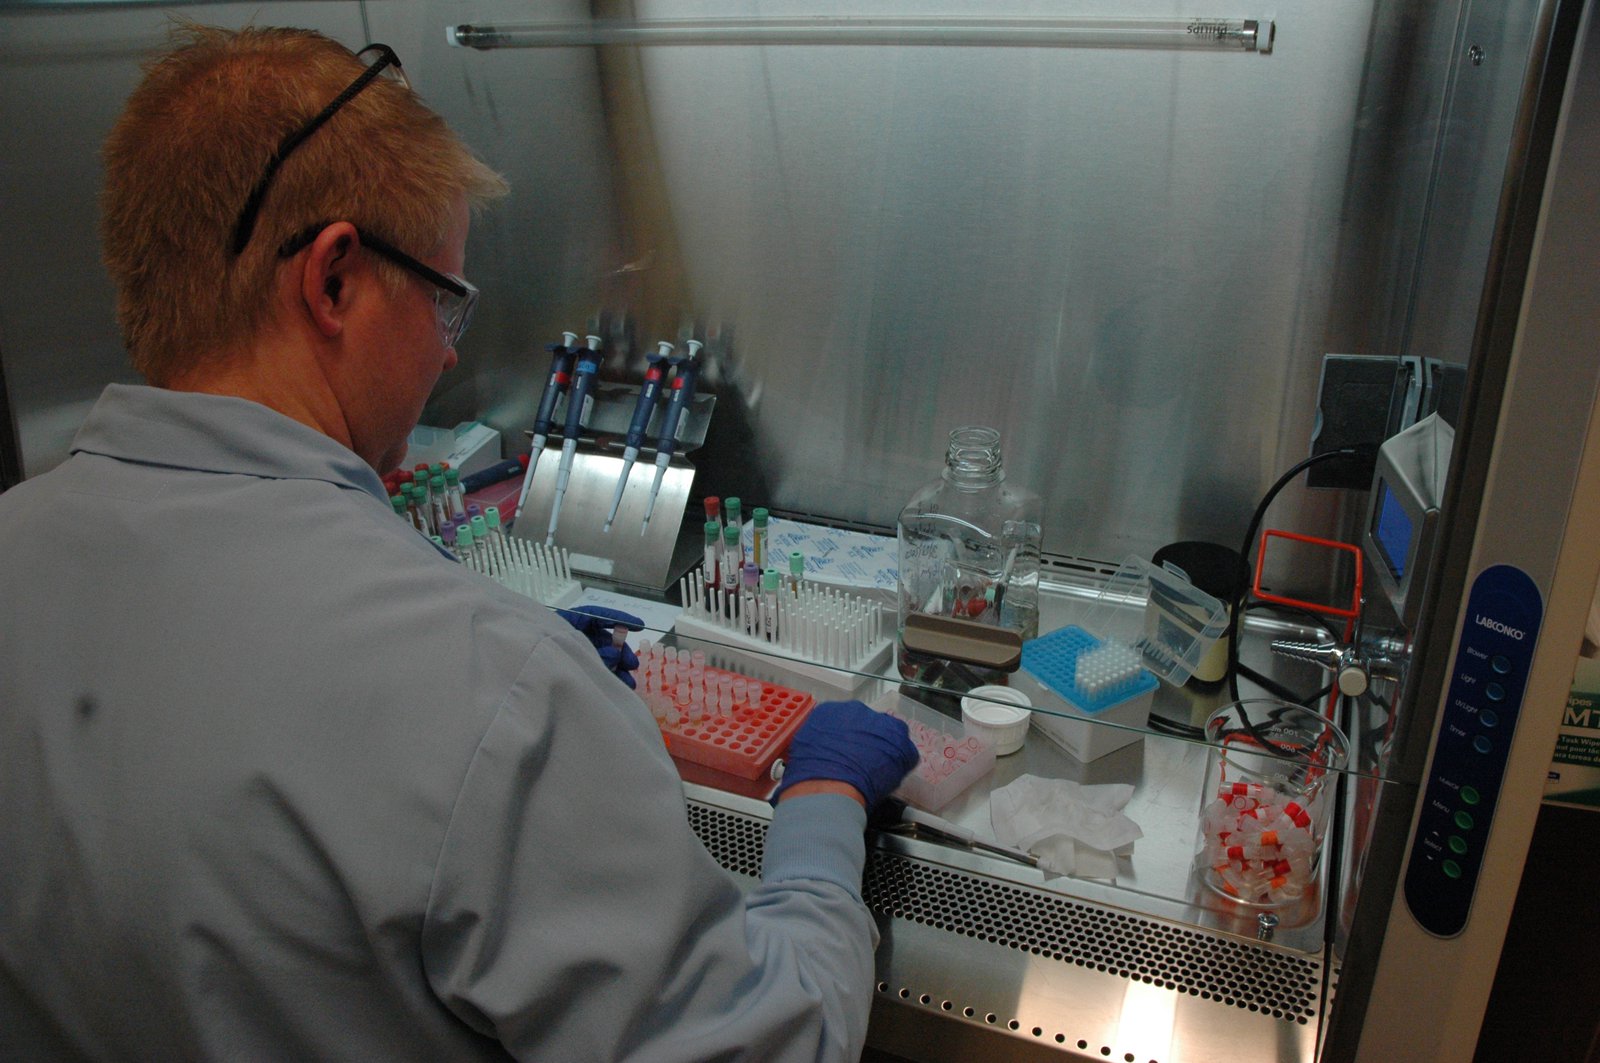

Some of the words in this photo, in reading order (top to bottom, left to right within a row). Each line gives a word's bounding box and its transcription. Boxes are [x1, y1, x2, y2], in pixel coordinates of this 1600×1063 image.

[1187, 25, 1228, 35] PHILIPS
[1475, 614, 1525, 640] LABCONCO
[1460, 672, 1477, 685] Light
